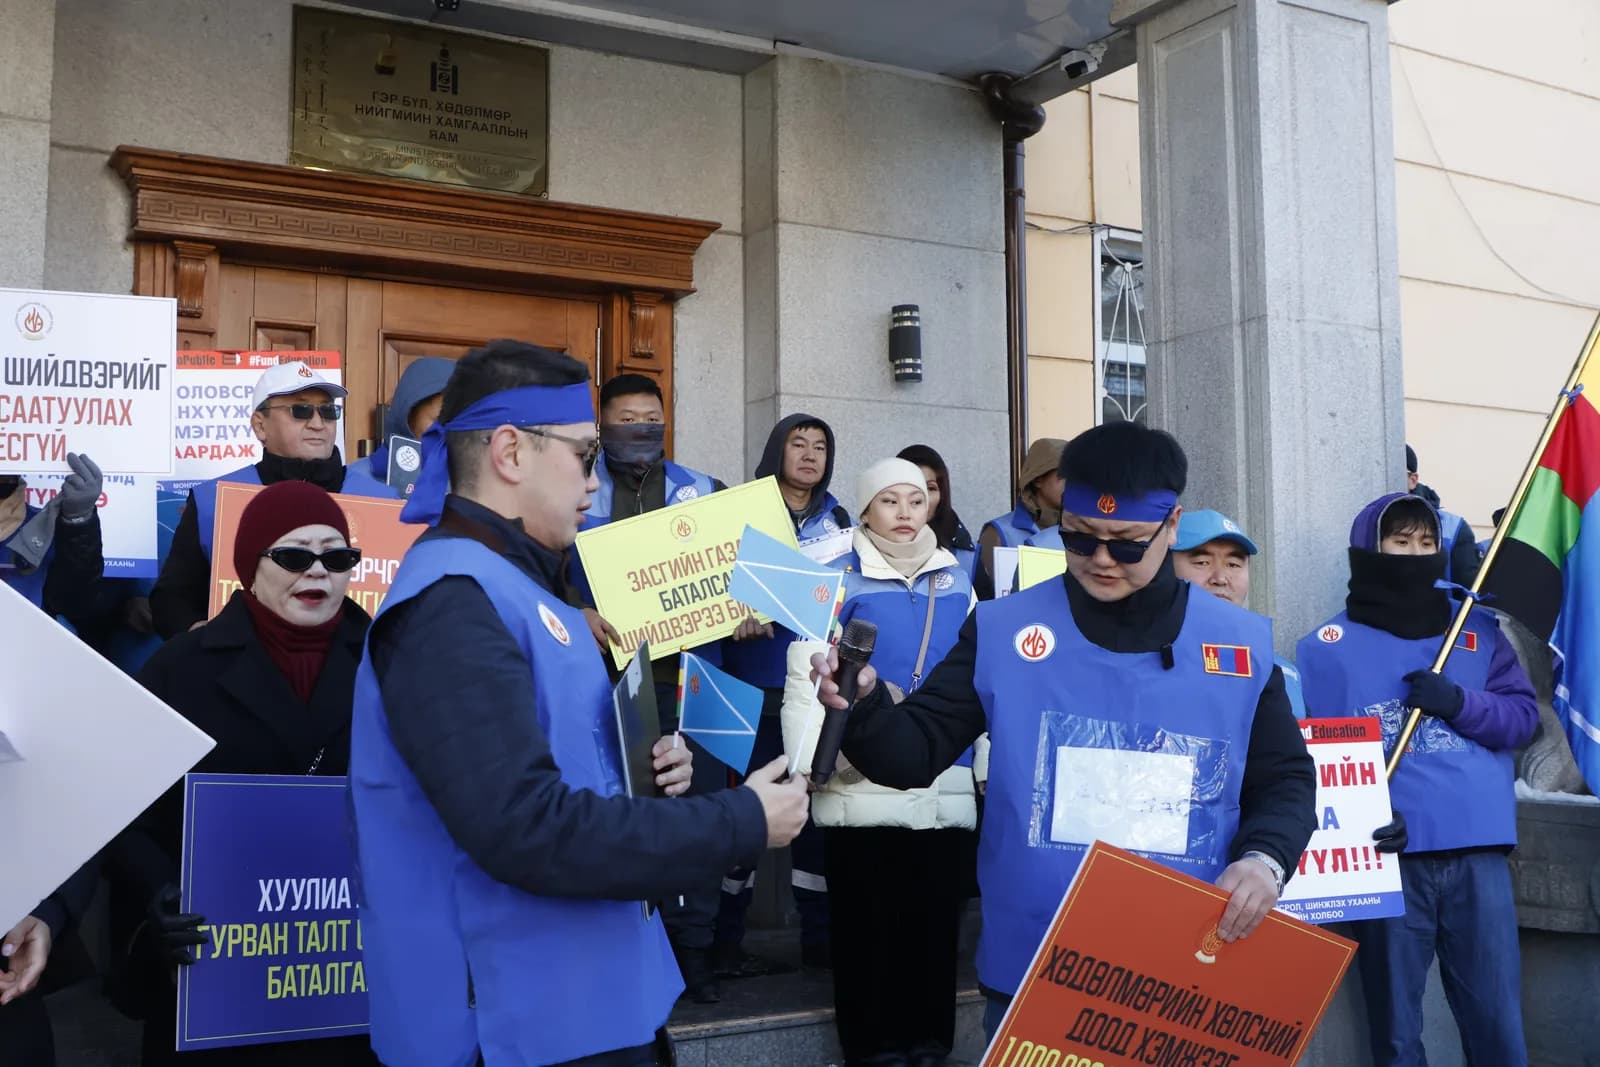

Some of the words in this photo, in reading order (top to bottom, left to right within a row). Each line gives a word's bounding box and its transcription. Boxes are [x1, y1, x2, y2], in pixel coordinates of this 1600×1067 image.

[371, 89, 398, 104] ГЭР
[429, 129, 459, 145] ЯАМ
[435, 115, 528, 140] ХАМГААЛЛЫН
[4, 353, 167, 391] ШИЙДВЭРИЙГ
[177, 385, 254, 399] ОЛОВСР
[0, 394, 133, 426] СААТУУЛАХ
[627, 551, 706, 593] ЗАСГИЙН
[658, 569, 735, 612] БАТАЛСА
[619, 603, 726, 655] ШИЙДВЭРЭЭ
[725, 598, 759, 621] БИ
[257, 876, 351, 912] ХУУЛИА
[1305, 899, 1346, 910] ШИНЖЛЭХ
[1348, 897, 1381, 907] УХААНЫ
[1310, 910, 1344, 920] ХОЛБОО
[294, 919, 351, 954] ТАЛТ
[266, 960, 369, 1000] БАТАЛГА
[1039, 945, 1211, 1030] ХӨДӨЛМӨРИЙН
[1202, 1000, 1303, 1060] ХӨЛСНИЙ
[1065, 1007, 1139, 1056] ДООД
